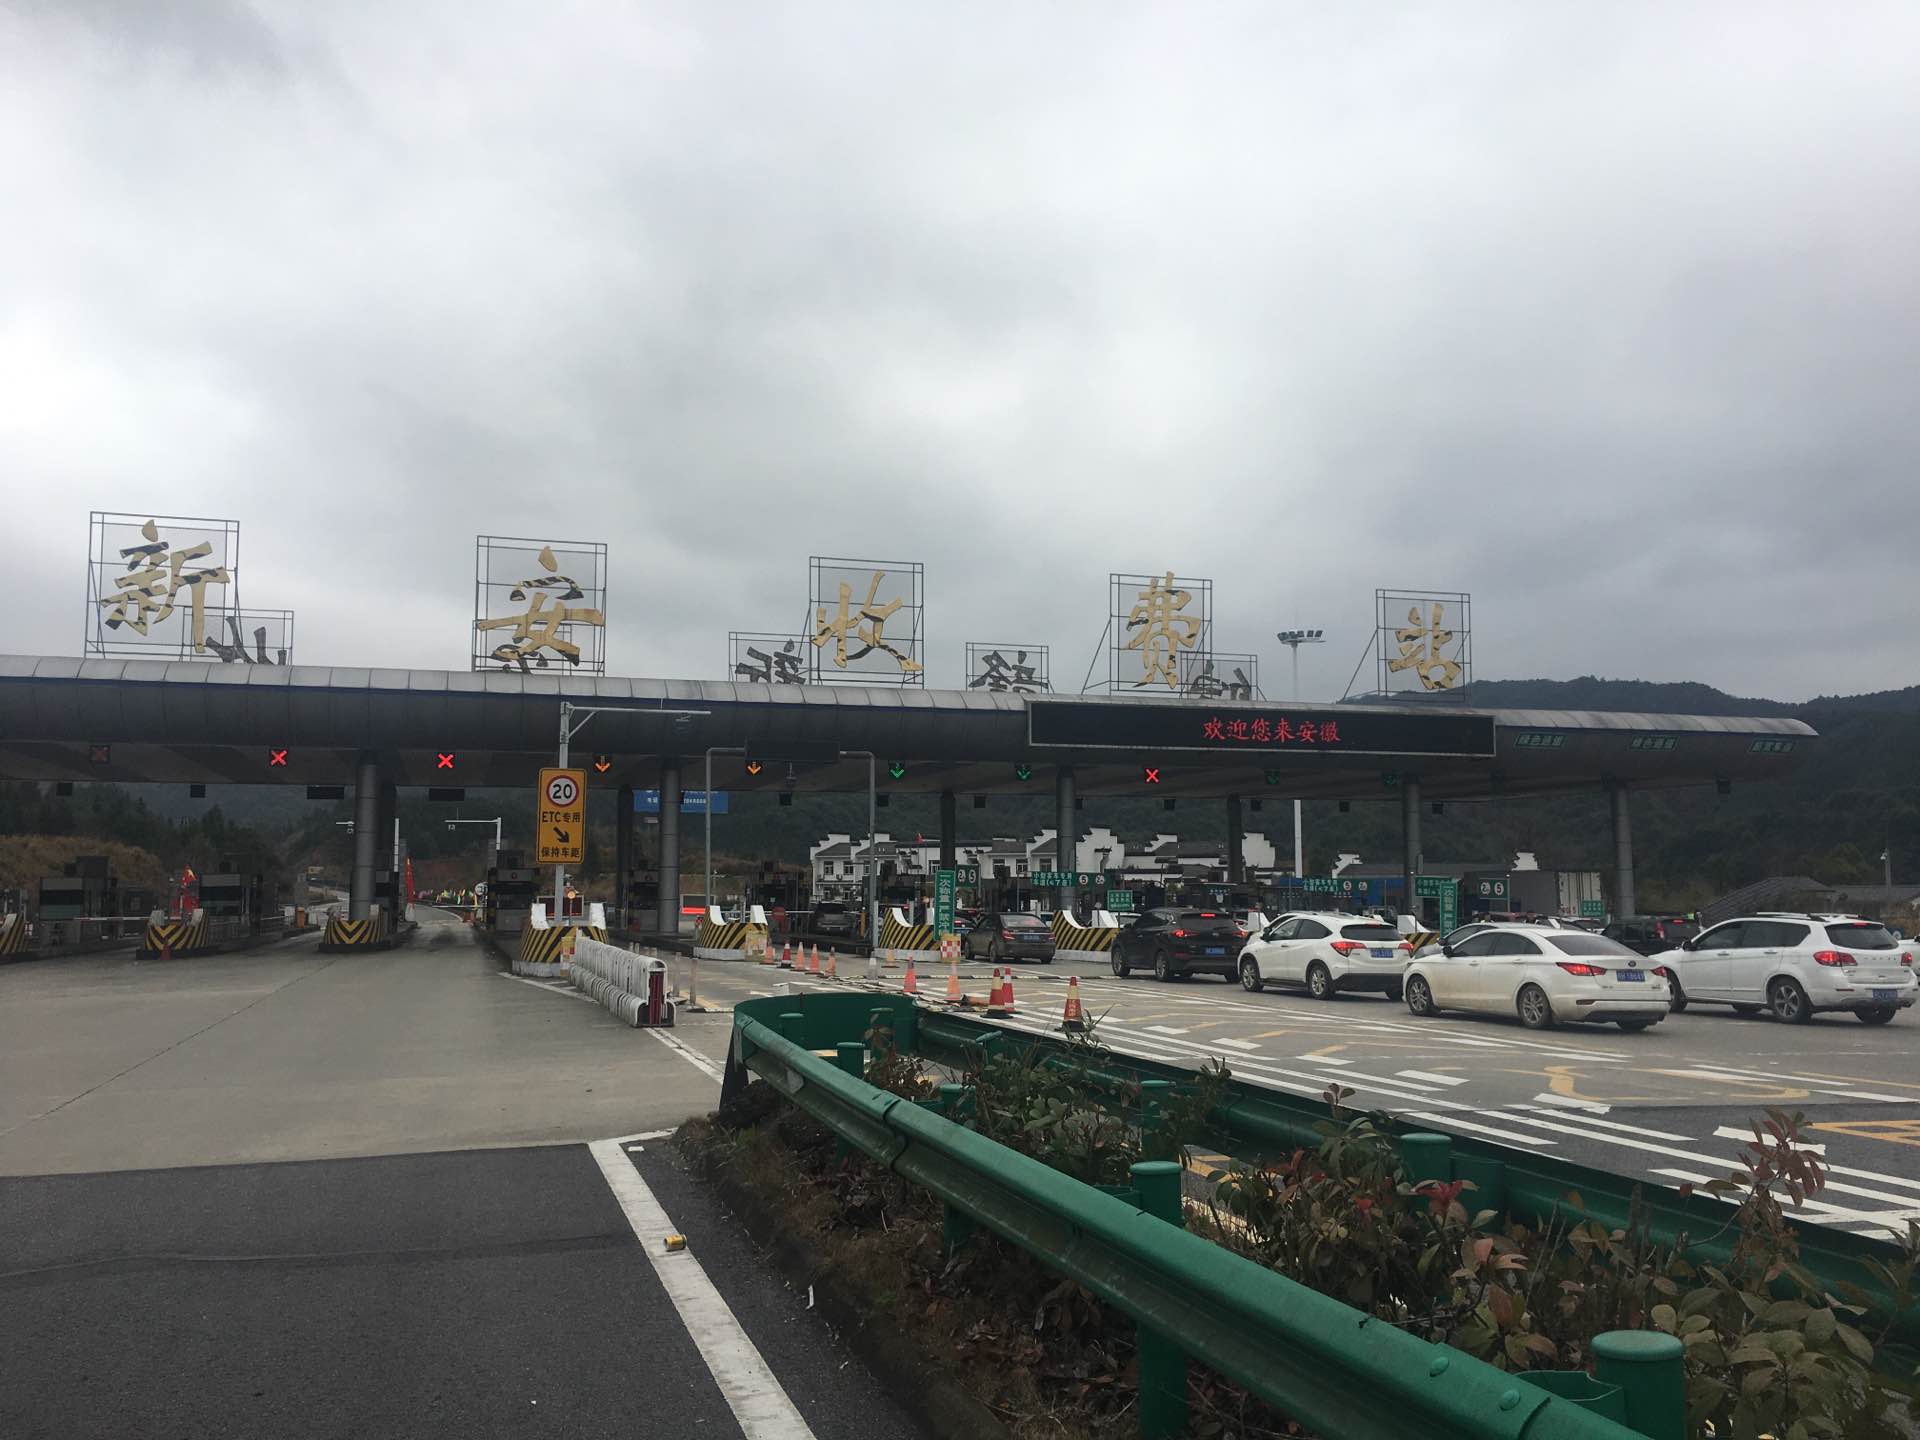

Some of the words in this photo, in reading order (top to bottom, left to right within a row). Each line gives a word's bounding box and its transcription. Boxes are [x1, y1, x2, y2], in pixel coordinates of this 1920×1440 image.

[1203, 716, 1343, 744] 欢迎您来安徽
[552, 783, 573, 799] 20
[541, 811, 581, 824] ETC专用
[541, 846, 581, 859] 保持车距
